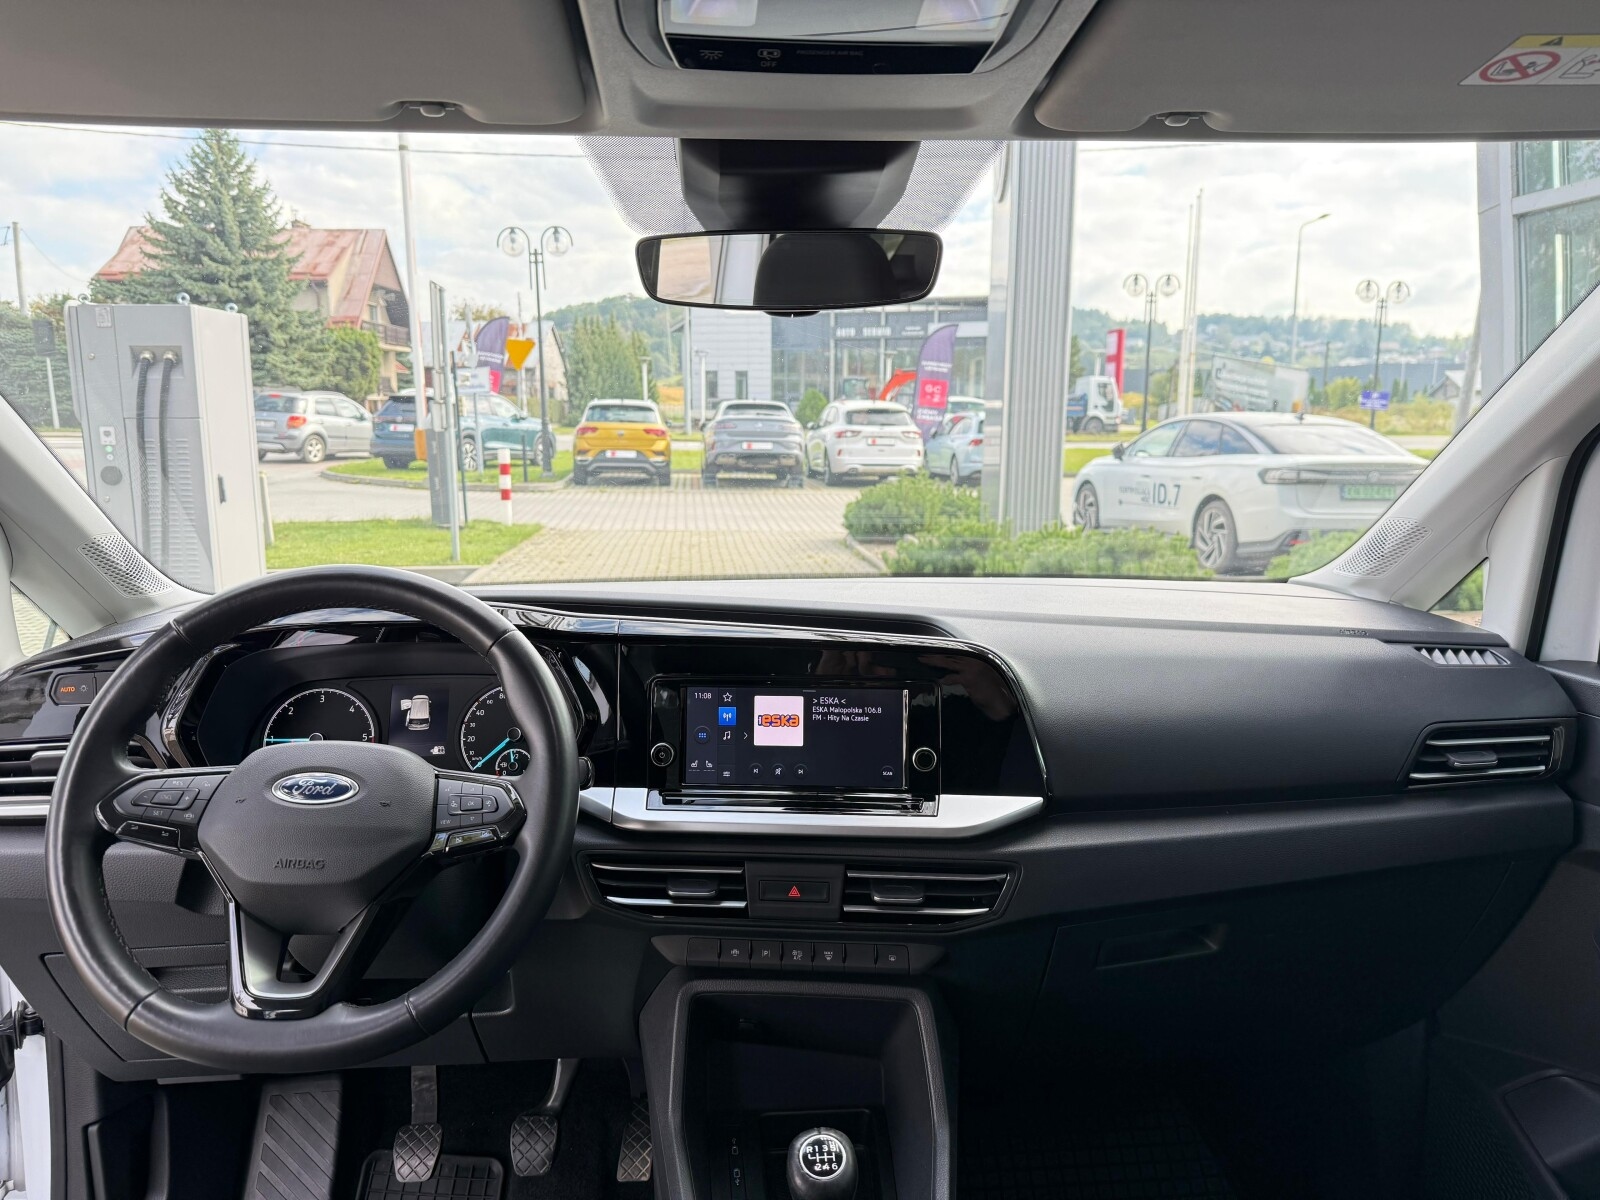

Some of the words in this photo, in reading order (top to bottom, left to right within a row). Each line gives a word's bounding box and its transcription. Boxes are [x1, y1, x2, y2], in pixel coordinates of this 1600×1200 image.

[319, 694, 325, 703] 3
[288, 707, 294, 715] 2
[349, 705, 355, 713] 4
[827, 714, 840, 722] Hity
[850, 714, 870, 722] Czasie
[362, 733, 368, 741] 5
[293, 779, 337, 795] Ford
[274, 858, 326, 869] AIRBAG
